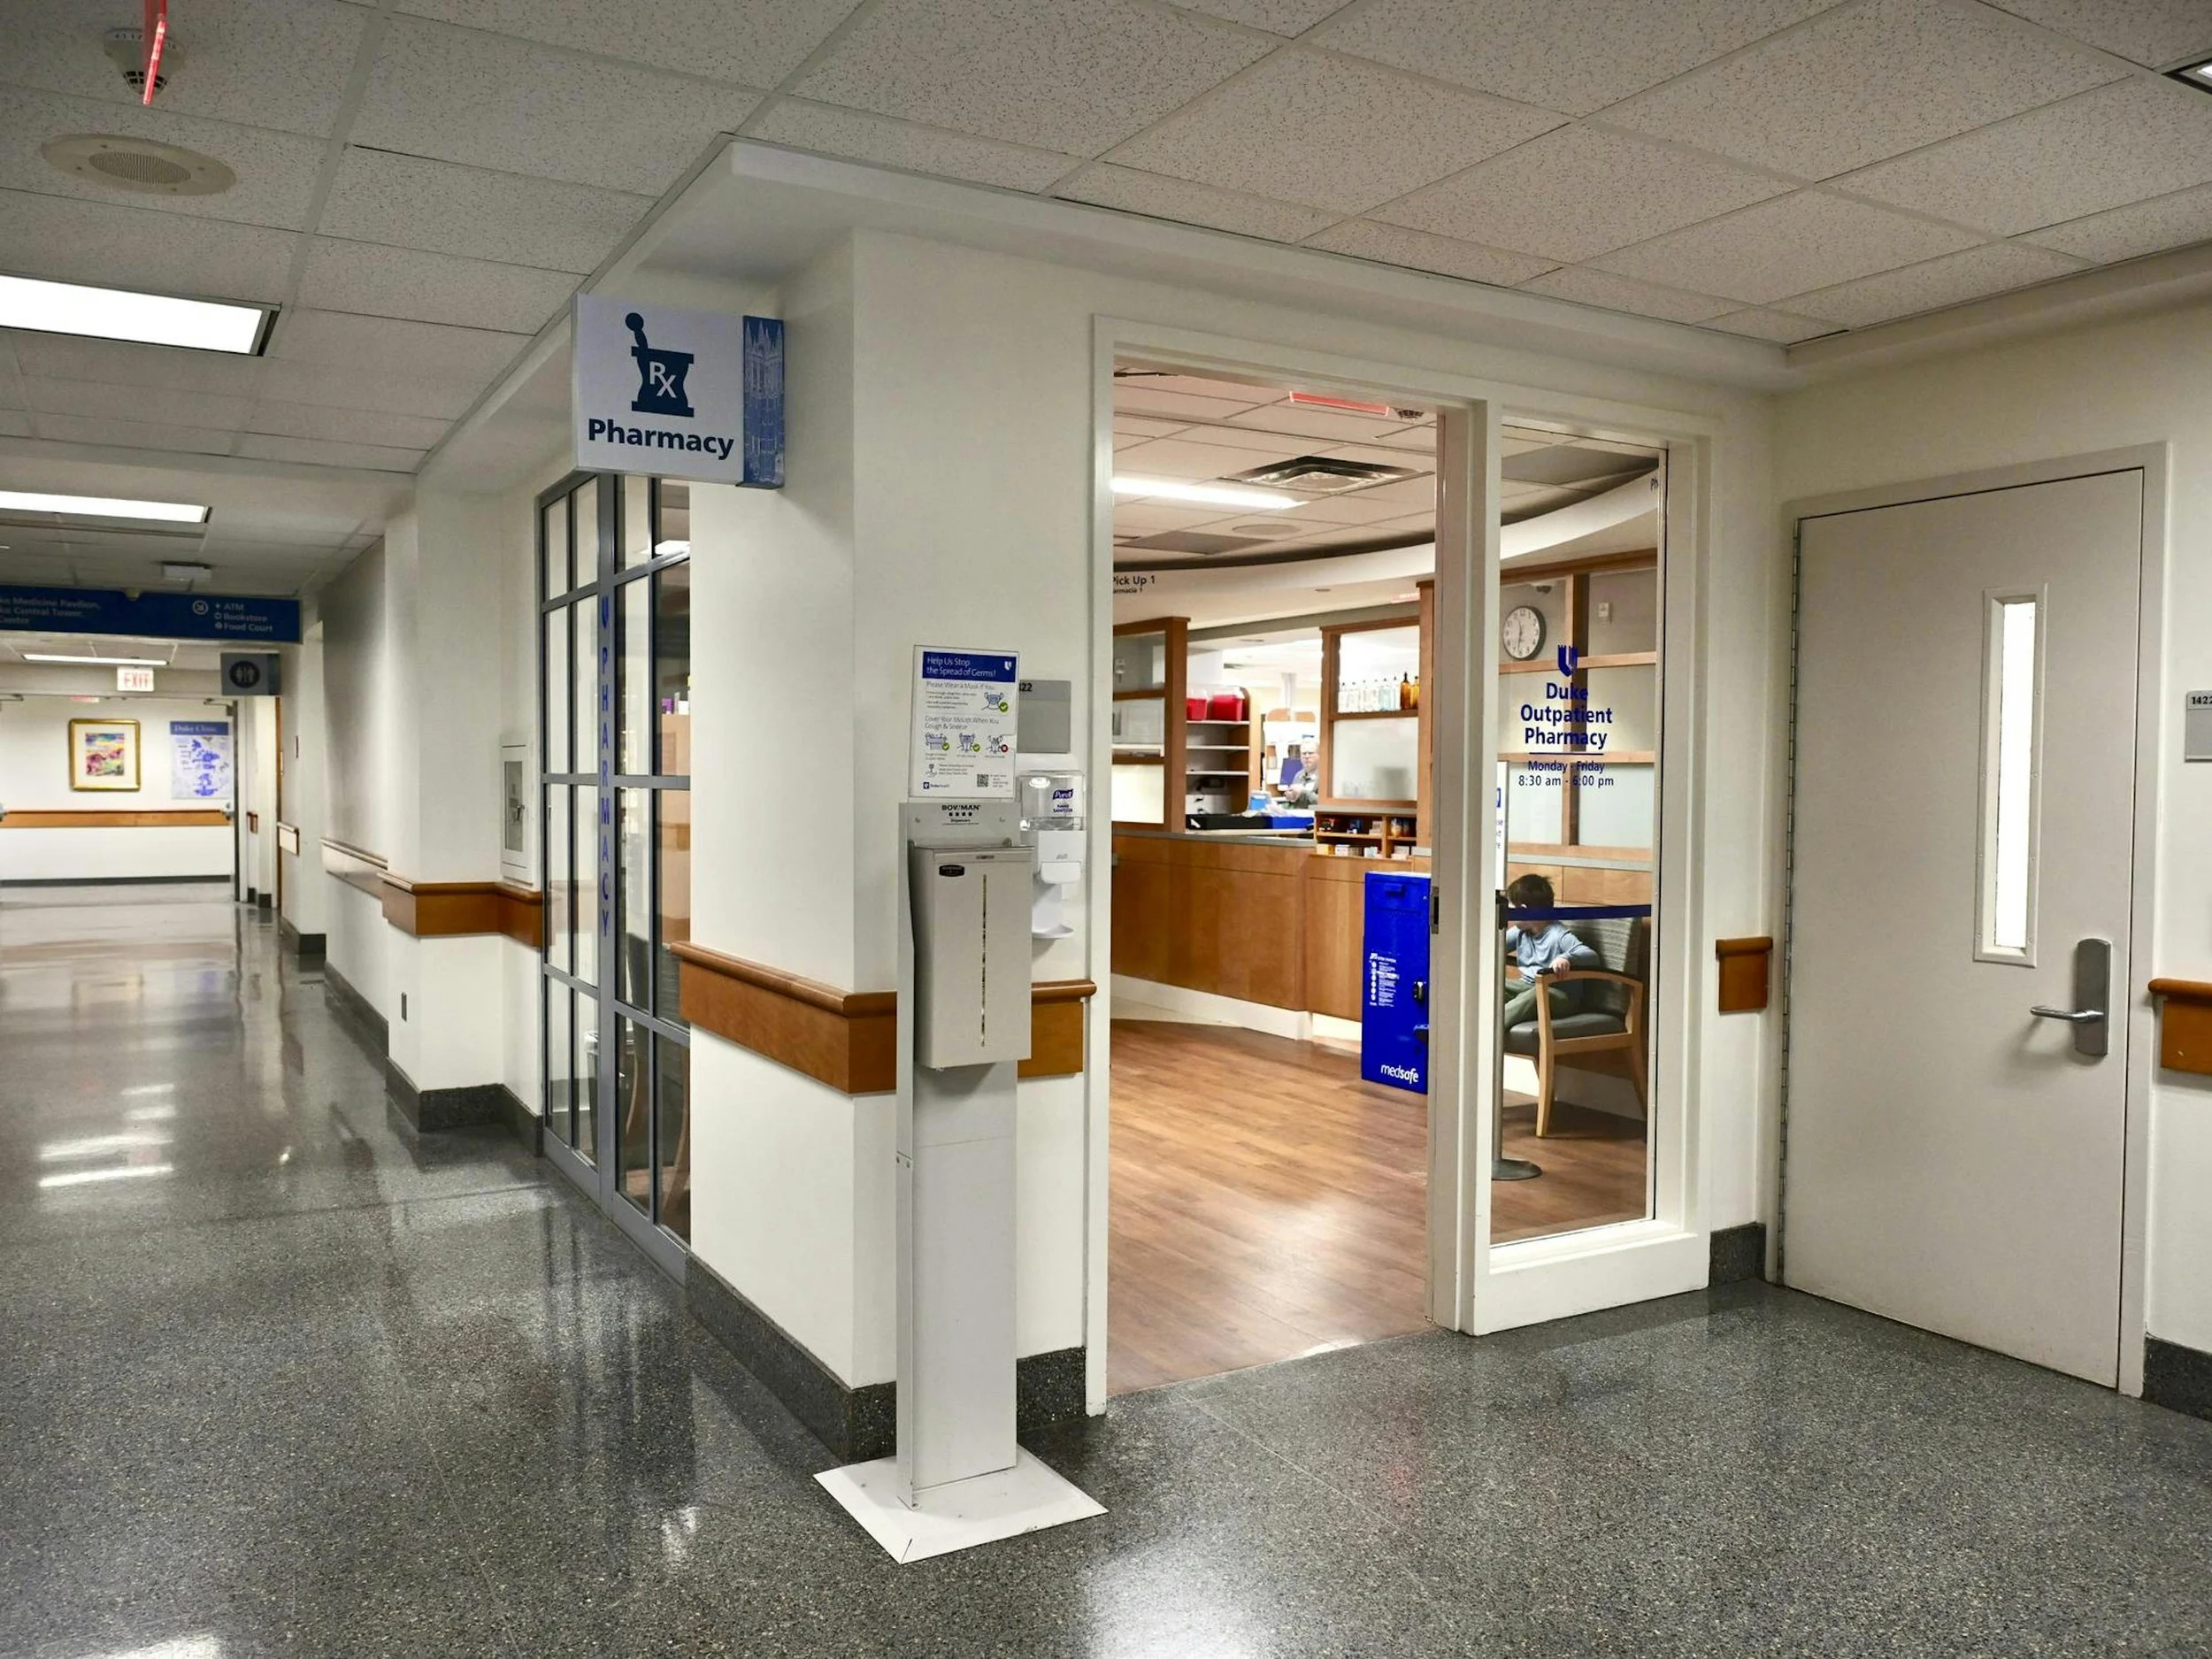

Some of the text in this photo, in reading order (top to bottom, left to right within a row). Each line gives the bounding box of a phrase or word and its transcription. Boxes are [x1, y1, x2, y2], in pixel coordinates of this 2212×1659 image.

[588, 418, 734, 460] Pharmacy
[1133, 576, 1147, 587] Up
[1150, 575, 1155, 584] 1
[223, 603, 245, 611] ATM
[224, 622, 273, 633] Food Court
[926, 657, 971, 668] Help Us Stop
[939, 666, 963, 677] Spread
[972, 668, 996, 677] Germs!
[124, 672, 150, 688] EXIT
[1546, 682, 1589, 700] Duke
[1520, 704, 1613, 726] Outpatient
[925, 722, 941, 731] Cough
[1525, 727, 1608, 749] Pharmacy
[1528, 761, 1568, 774] Monday
[1577, 761, 1606, 774] Friday
[1518, 775, 1541, 787] 8:30
[1546, 778, 1561, 787] am
[1572, 775, 1594, 787] 6:00
[1598, 778, 1614, 788] pm
[601, 647, 610, 937] PHARMACY
[1380, 1064, 1419, 1085] medsafe
